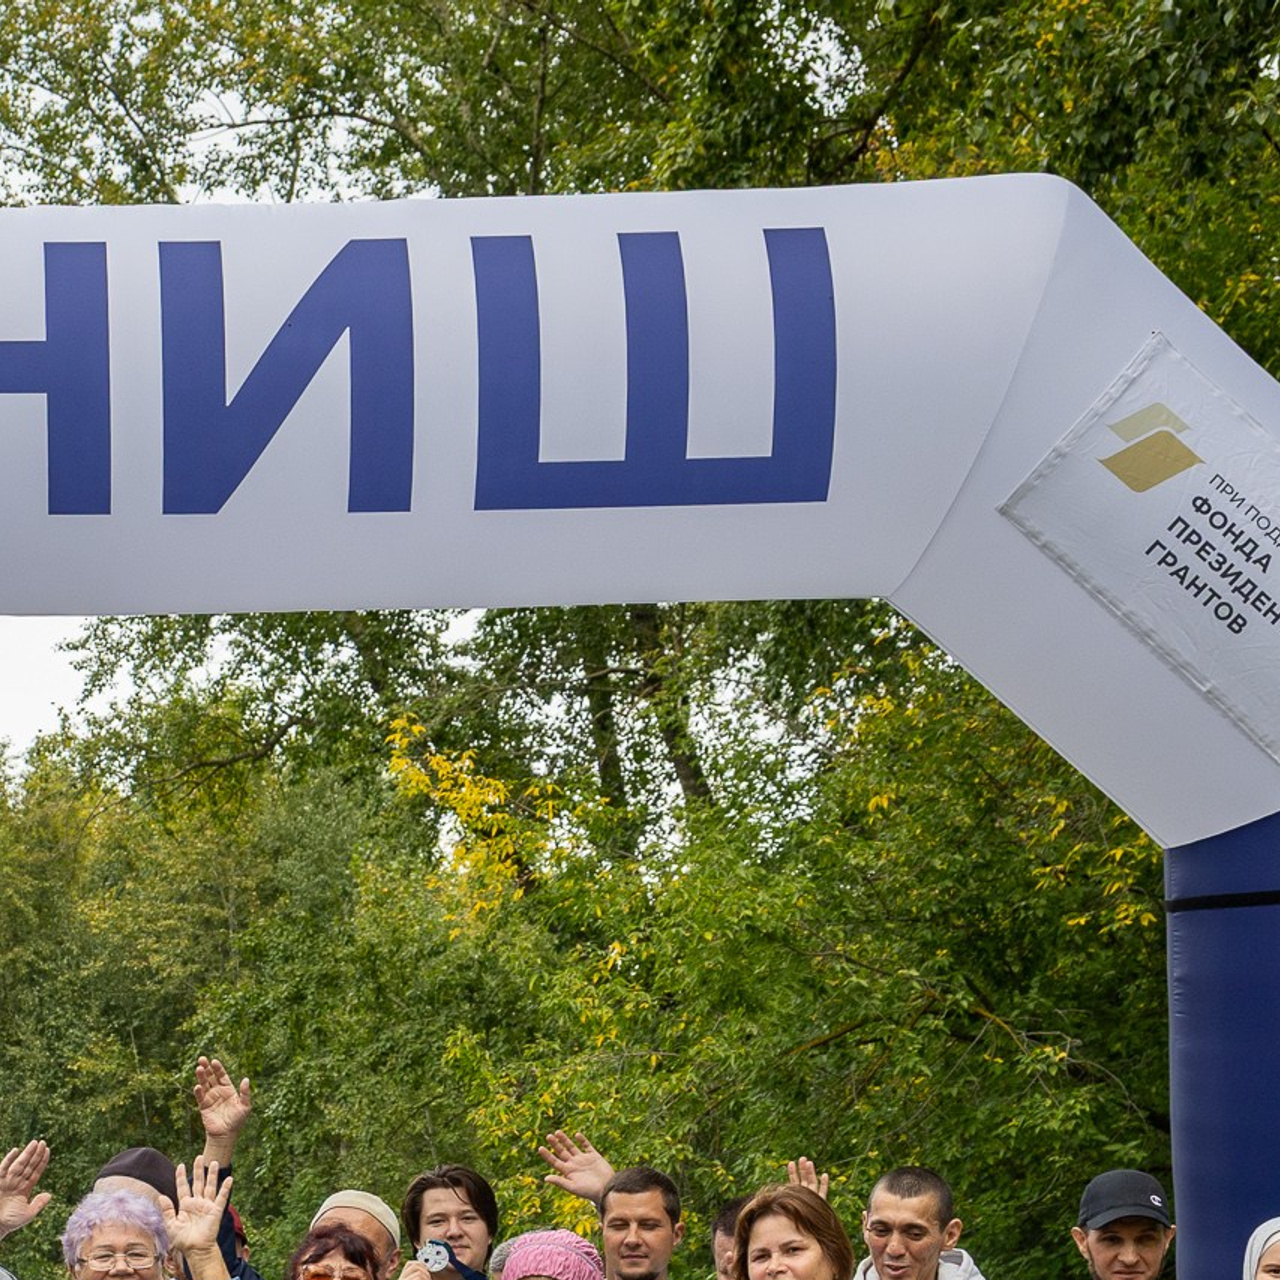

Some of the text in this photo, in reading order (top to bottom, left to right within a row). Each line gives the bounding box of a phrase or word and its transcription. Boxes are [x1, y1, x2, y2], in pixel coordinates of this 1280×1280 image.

[1192, 495, 1272, 574] ФОНДА
[1209, 474, 1280, 547] ПРИ ПОД
[1145, 539, 1248, 634] ГРАНТОВ
